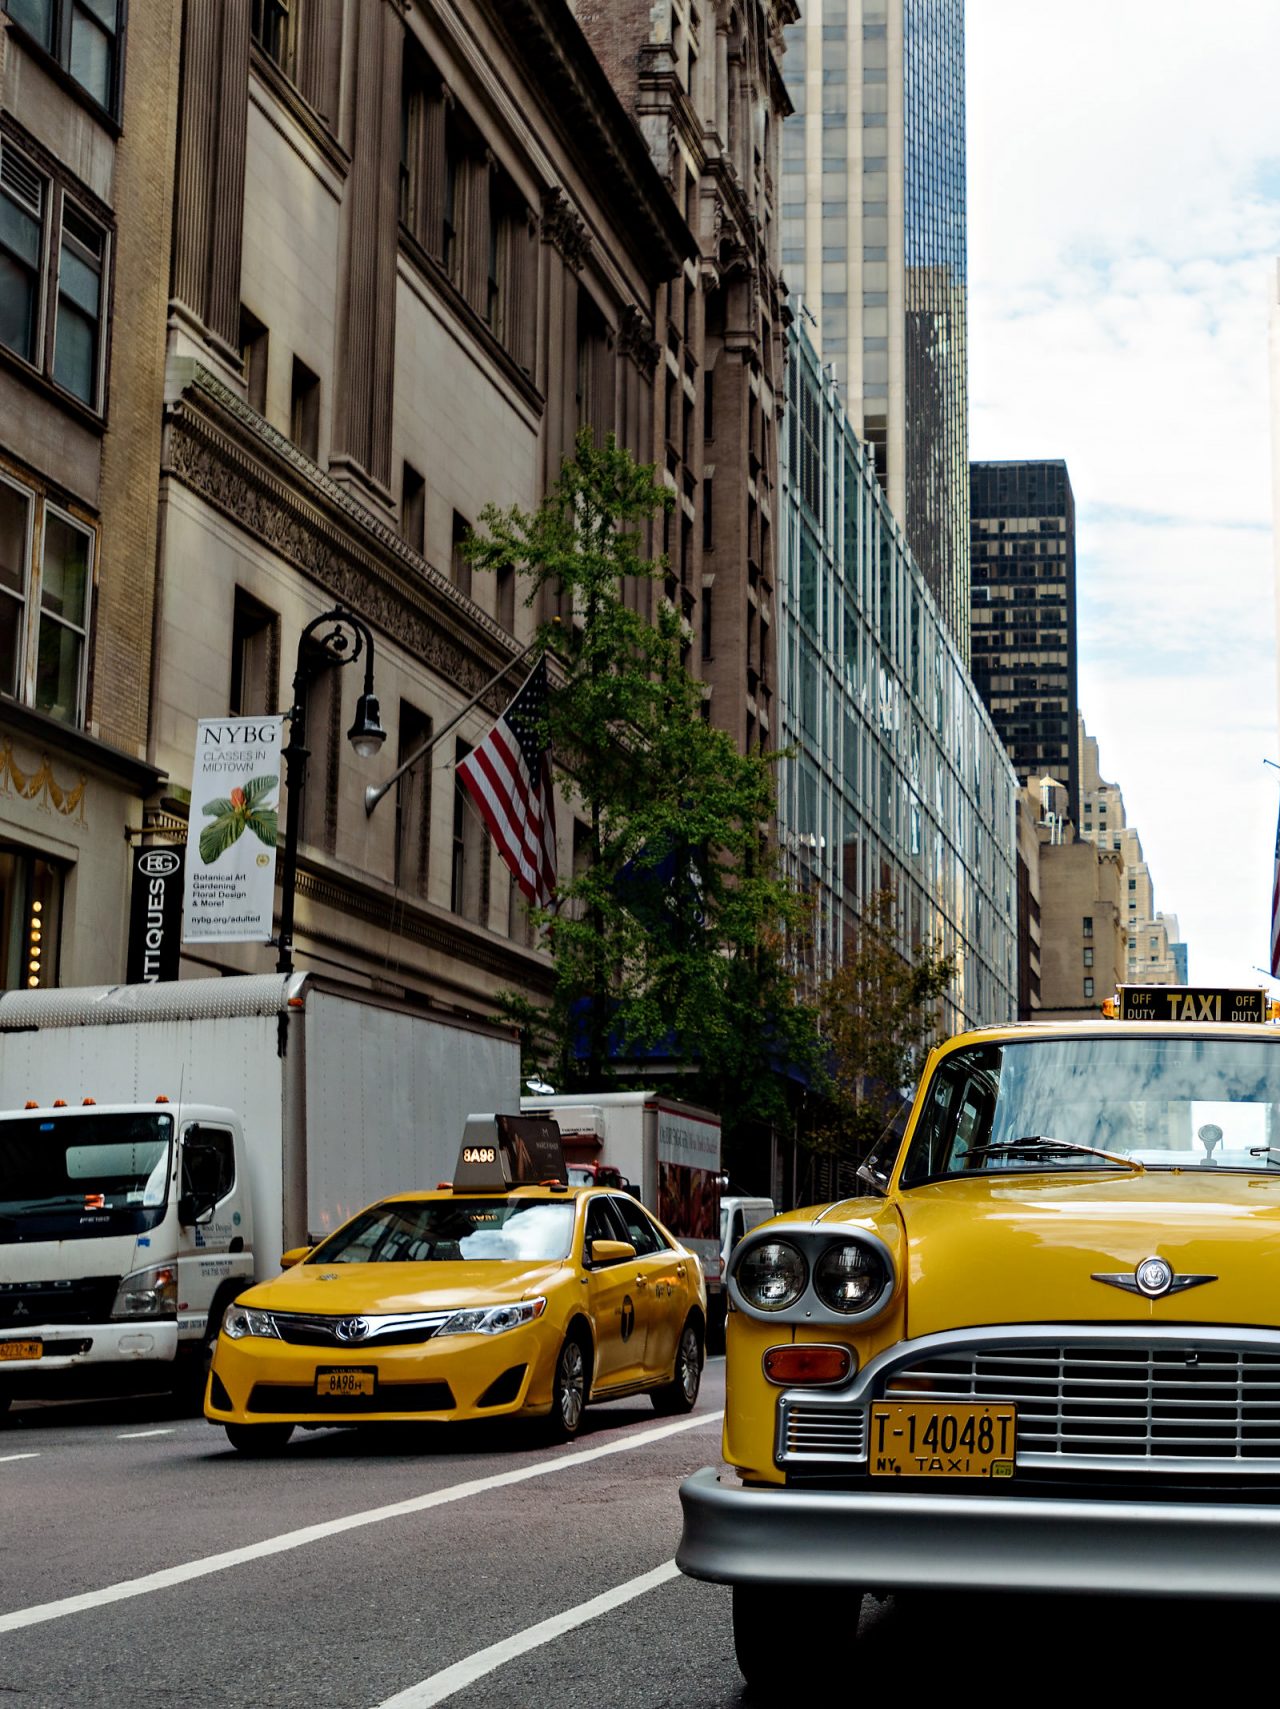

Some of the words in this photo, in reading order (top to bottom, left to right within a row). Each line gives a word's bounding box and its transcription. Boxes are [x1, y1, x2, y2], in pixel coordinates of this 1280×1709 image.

[203, 724, 277, 745] NYBG
[203, 750, 253, 761] CLASSES
[255, 750, 266, 760] IN
[202, 762, 254, 772] MIDTOWN
[193, 873, 233, 881] Botanical
[234, 873, 246, 881] Art
[192, 882, 236, 890] Gardening
[218, 891, 247, 899] Design
[191, 915, 261, 924] nybg.org/adulted
[1132, 993, 1152, 1005] OFF
[1235, 995, 1255, 1007] OFF
[1167, 994, 1222, 1021] TAXI
[1127, 1008, 1156, 1020] DUTY
[1231, 1010, 1260, 1022] DUTY
[463, 1148, 495, 1163] 8A98
[874, 1413, 1013, 1456] T-14048T
[876, 1457, 897, 1471] NY
[915, 1457, 970, 1472] TAXI
